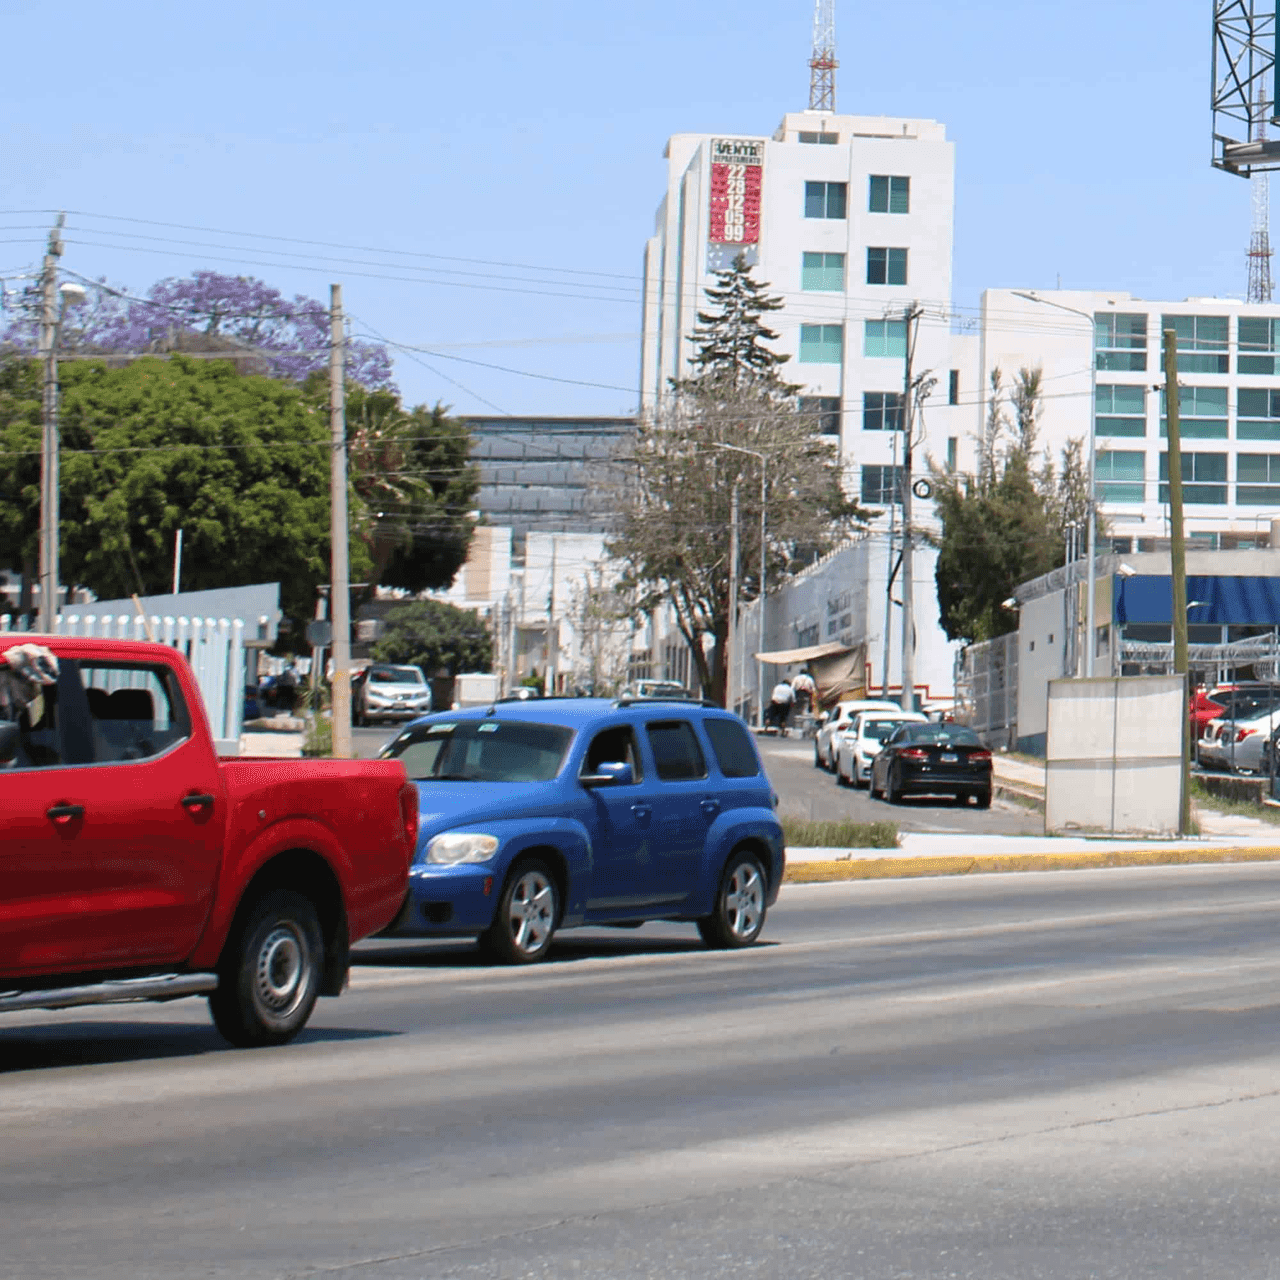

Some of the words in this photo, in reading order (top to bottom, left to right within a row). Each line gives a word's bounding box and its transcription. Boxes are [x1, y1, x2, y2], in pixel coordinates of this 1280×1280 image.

[717, 143, 758, 156] VENTA
[728, 165, 746, 180] 22
[727, 195, 745, 210] 12
[724, 224, 744, 242] 99
